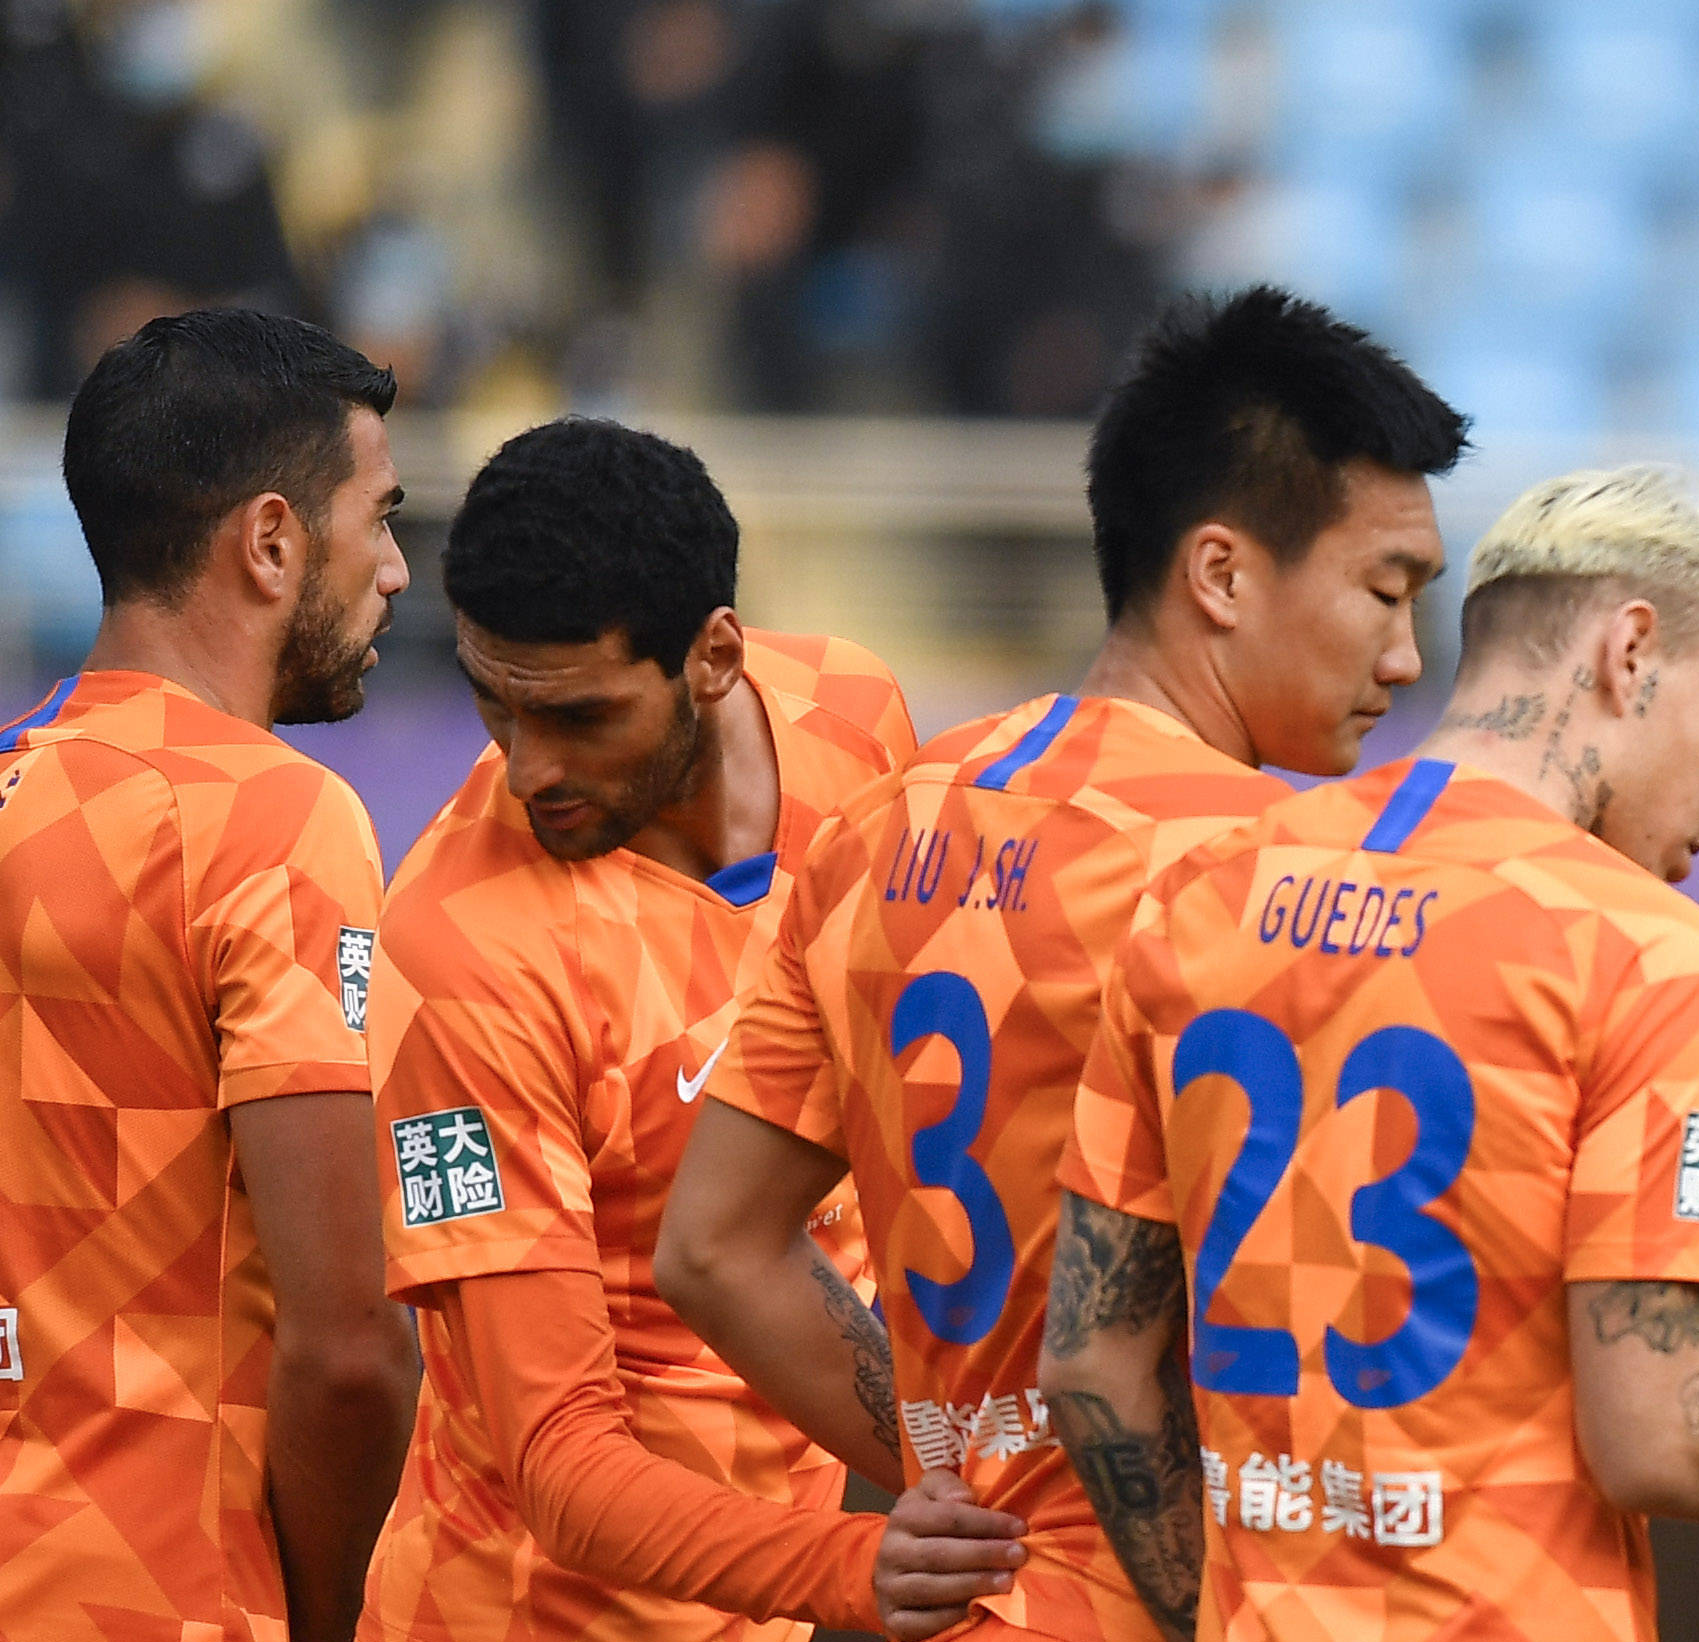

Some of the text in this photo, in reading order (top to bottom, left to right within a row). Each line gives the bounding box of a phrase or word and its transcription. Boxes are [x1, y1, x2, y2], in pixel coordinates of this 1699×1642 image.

[885, 828, 951, 904] LIU
[1260, 875, 1438, 957] GUEDES
[396, 1112, 489, 1172] 英大
[890, 971, 1014, 1344] 3
[404, 1161, 499, 1222] 财险
[1172, 1009, 1478, 1409] 23
